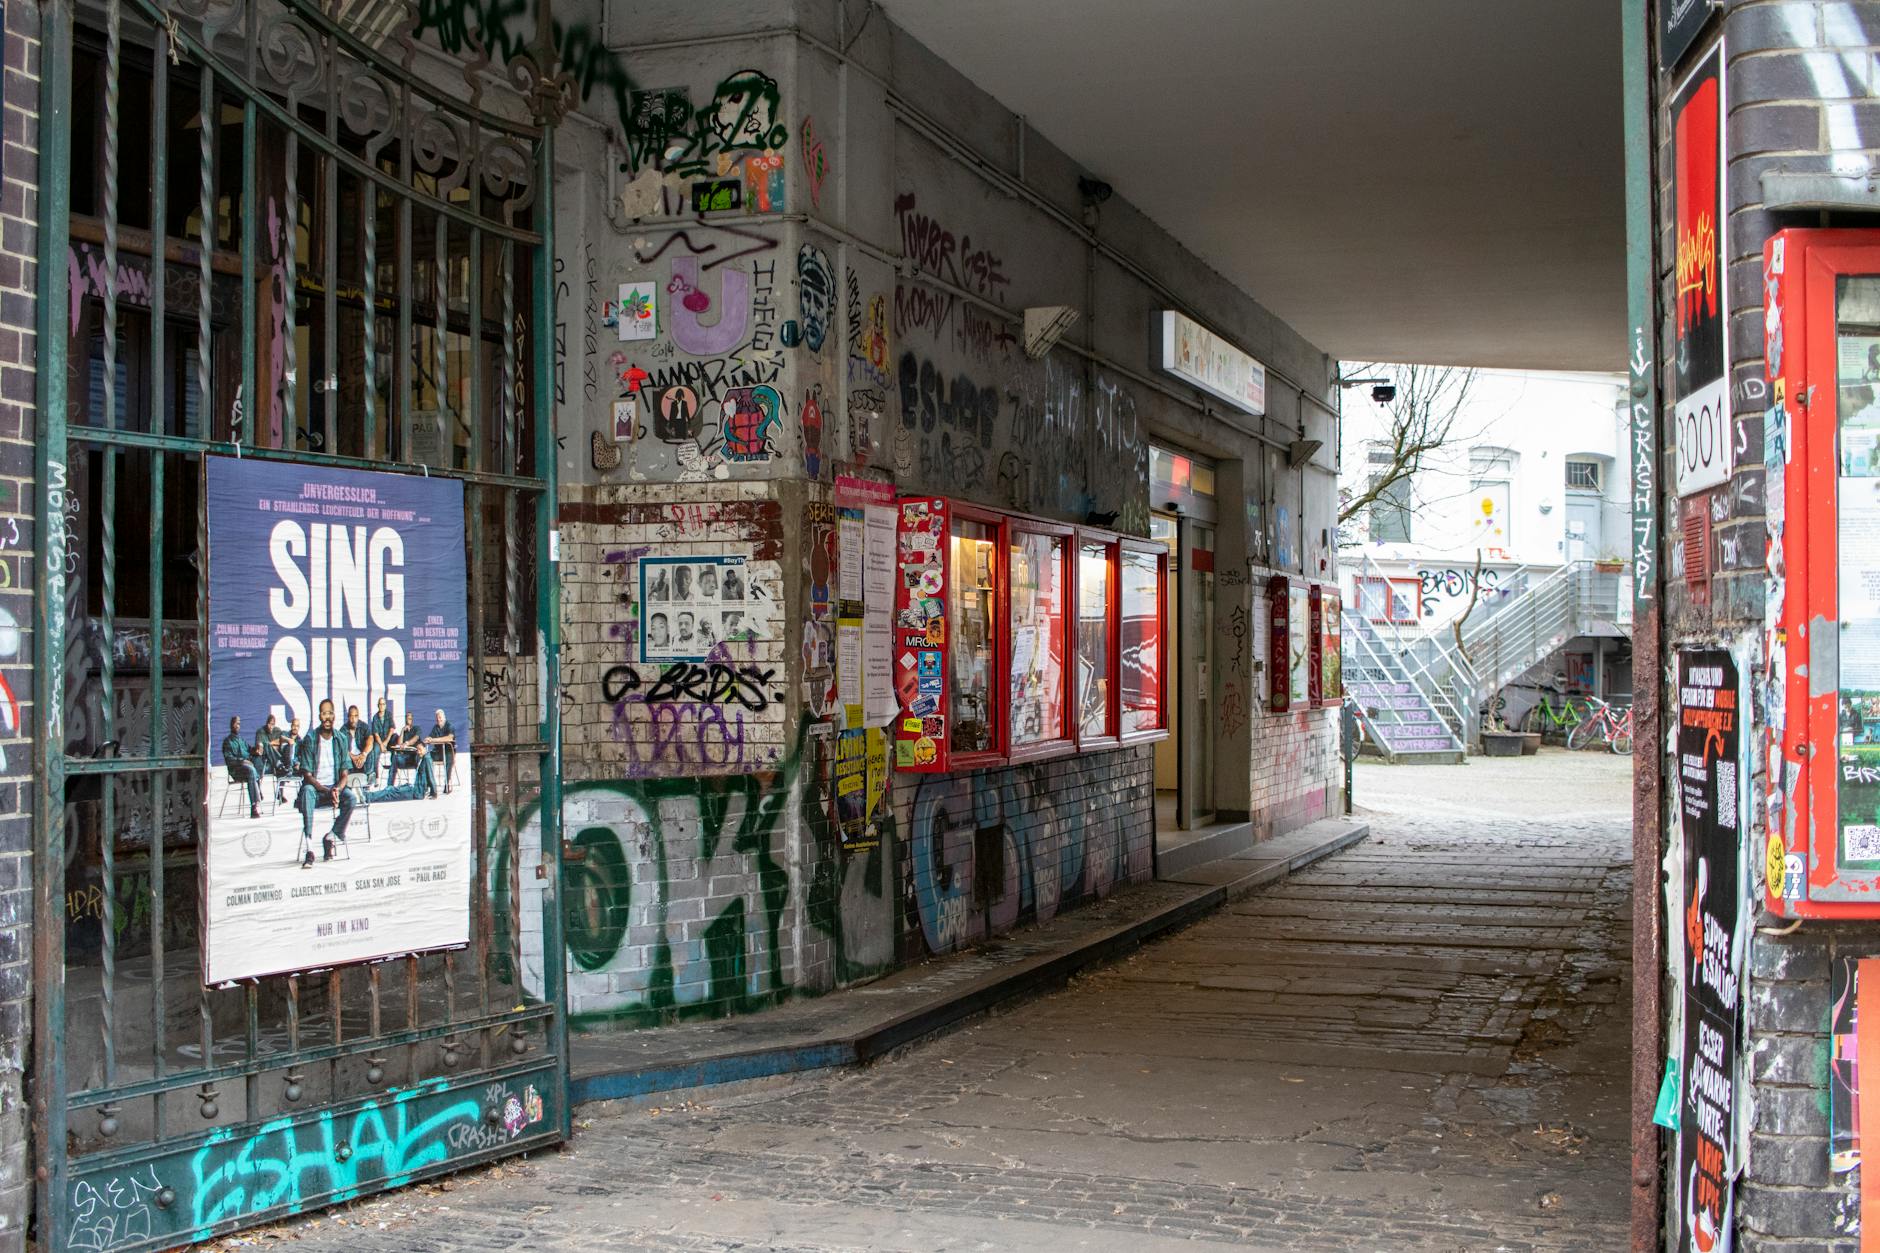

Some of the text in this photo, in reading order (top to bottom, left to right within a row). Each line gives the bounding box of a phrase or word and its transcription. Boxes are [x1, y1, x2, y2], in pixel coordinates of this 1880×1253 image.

[1632, 403, 1651, 513] CRASH
[270, 520, 404, 630] SING
[270, 636, 406, 742] SING
[355, 878, 371, 890] SEAN
[372, 877, 386, 888] SAN
[416, 872, 430, 882] PAUL
[226, 889, 282, 907] COLMAN DOMINGO
[291, 882, 348, 898] CLARENCE MACLIN
[317, 918, 369, 937] NUR IM KINO
